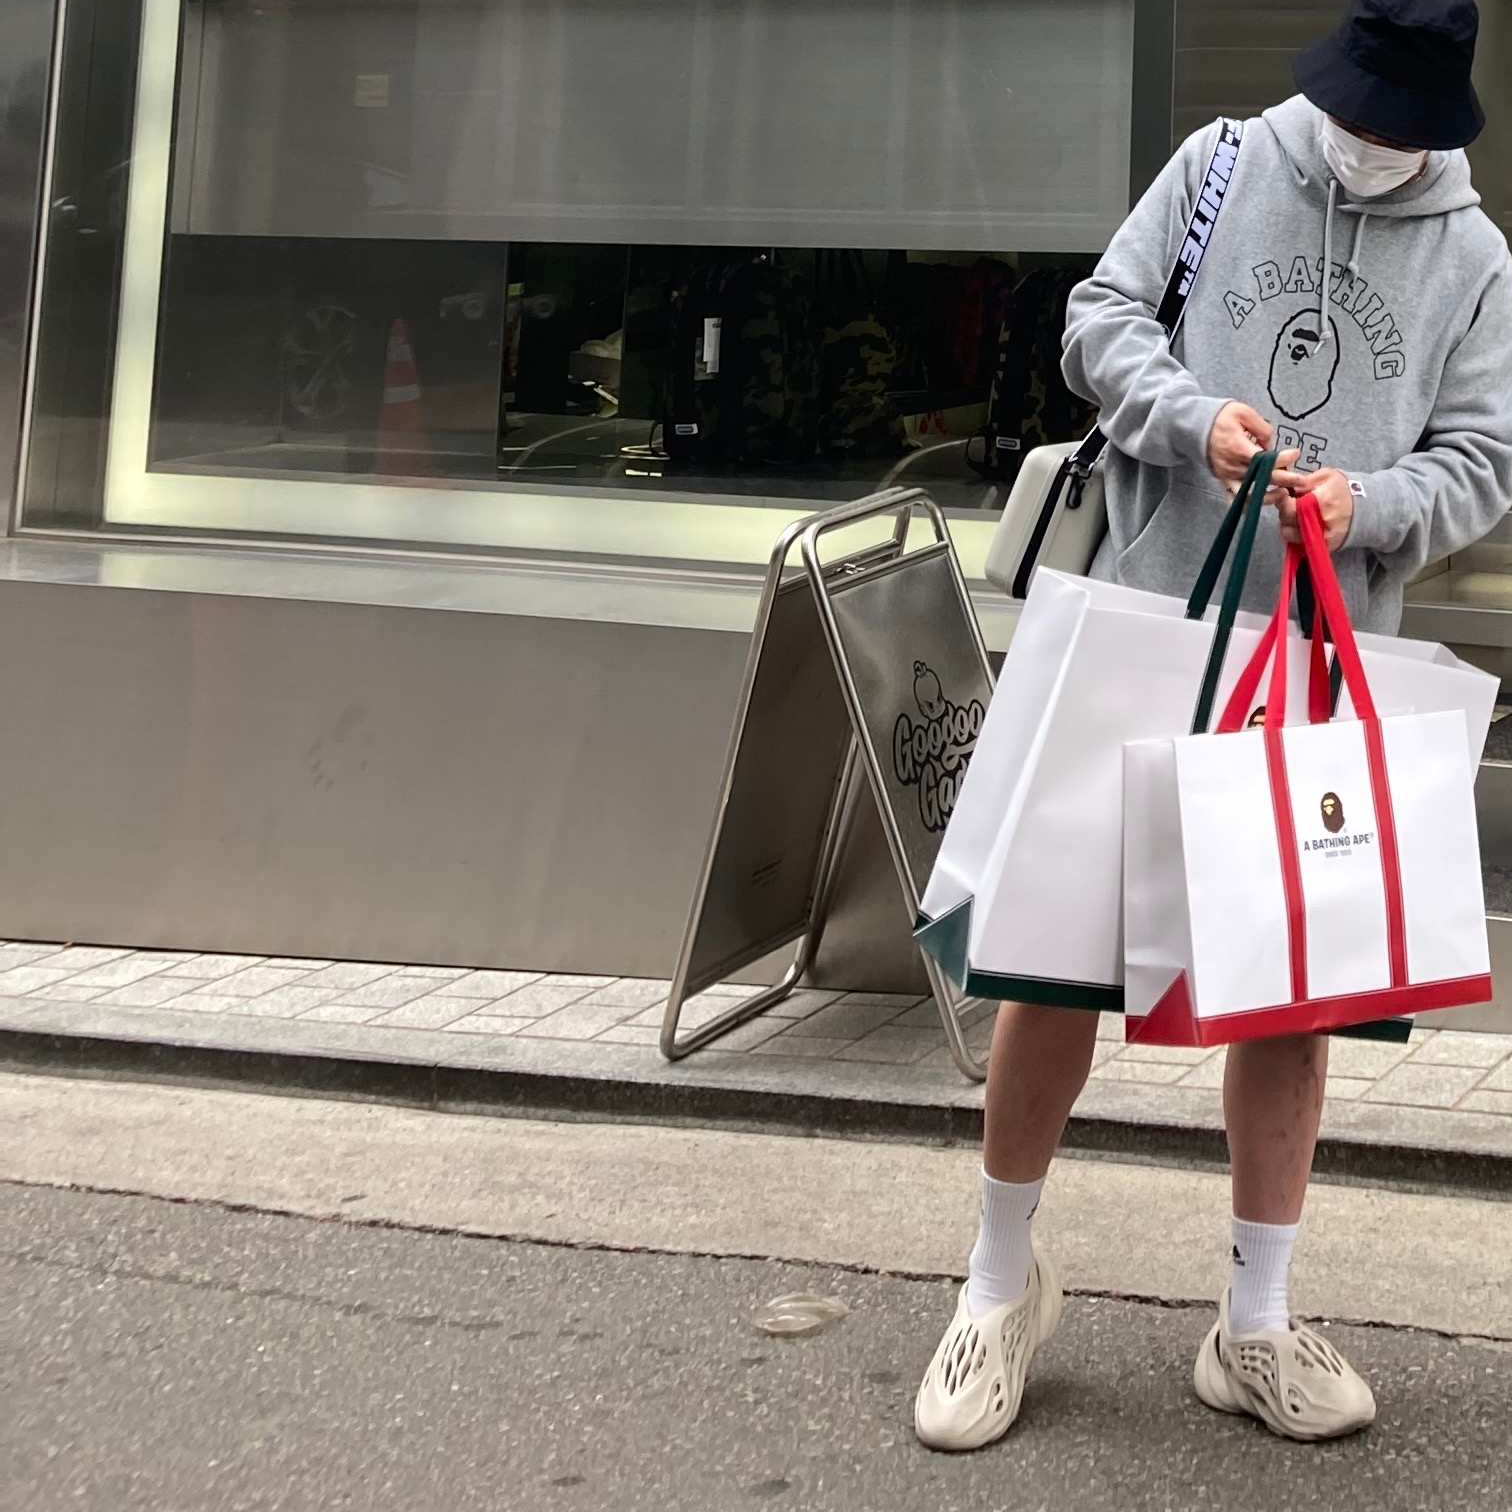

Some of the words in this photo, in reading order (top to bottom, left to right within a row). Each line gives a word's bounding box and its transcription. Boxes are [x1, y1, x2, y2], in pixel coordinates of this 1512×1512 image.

[1223, 290, 1256, 329] A
[1252, 255, 1406, 381] BATHING
[1304, 841, 1311, 851] A
[1312, 835, 1351, 851] BATHING
